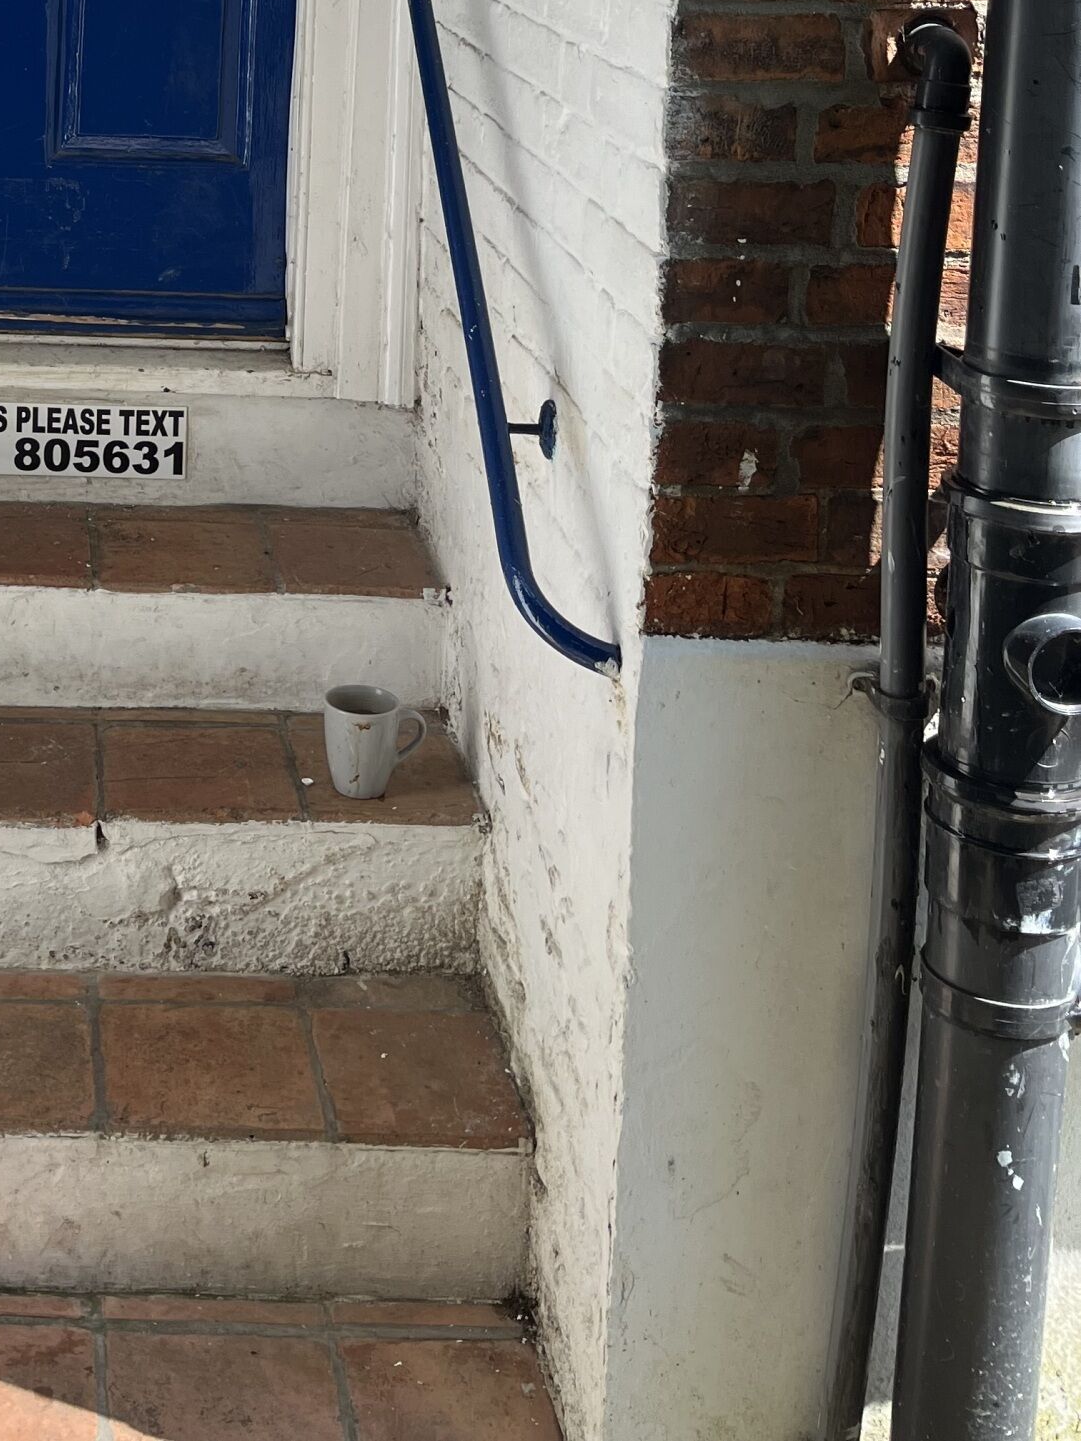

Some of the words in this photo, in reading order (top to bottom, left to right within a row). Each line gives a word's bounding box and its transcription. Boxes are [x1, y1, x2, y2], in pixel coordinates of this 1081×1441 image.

[16, 406, 111, 436] PLEASE
[118, 409, 185, 437] TEXT
[13, 438, 184, 476] 805631
